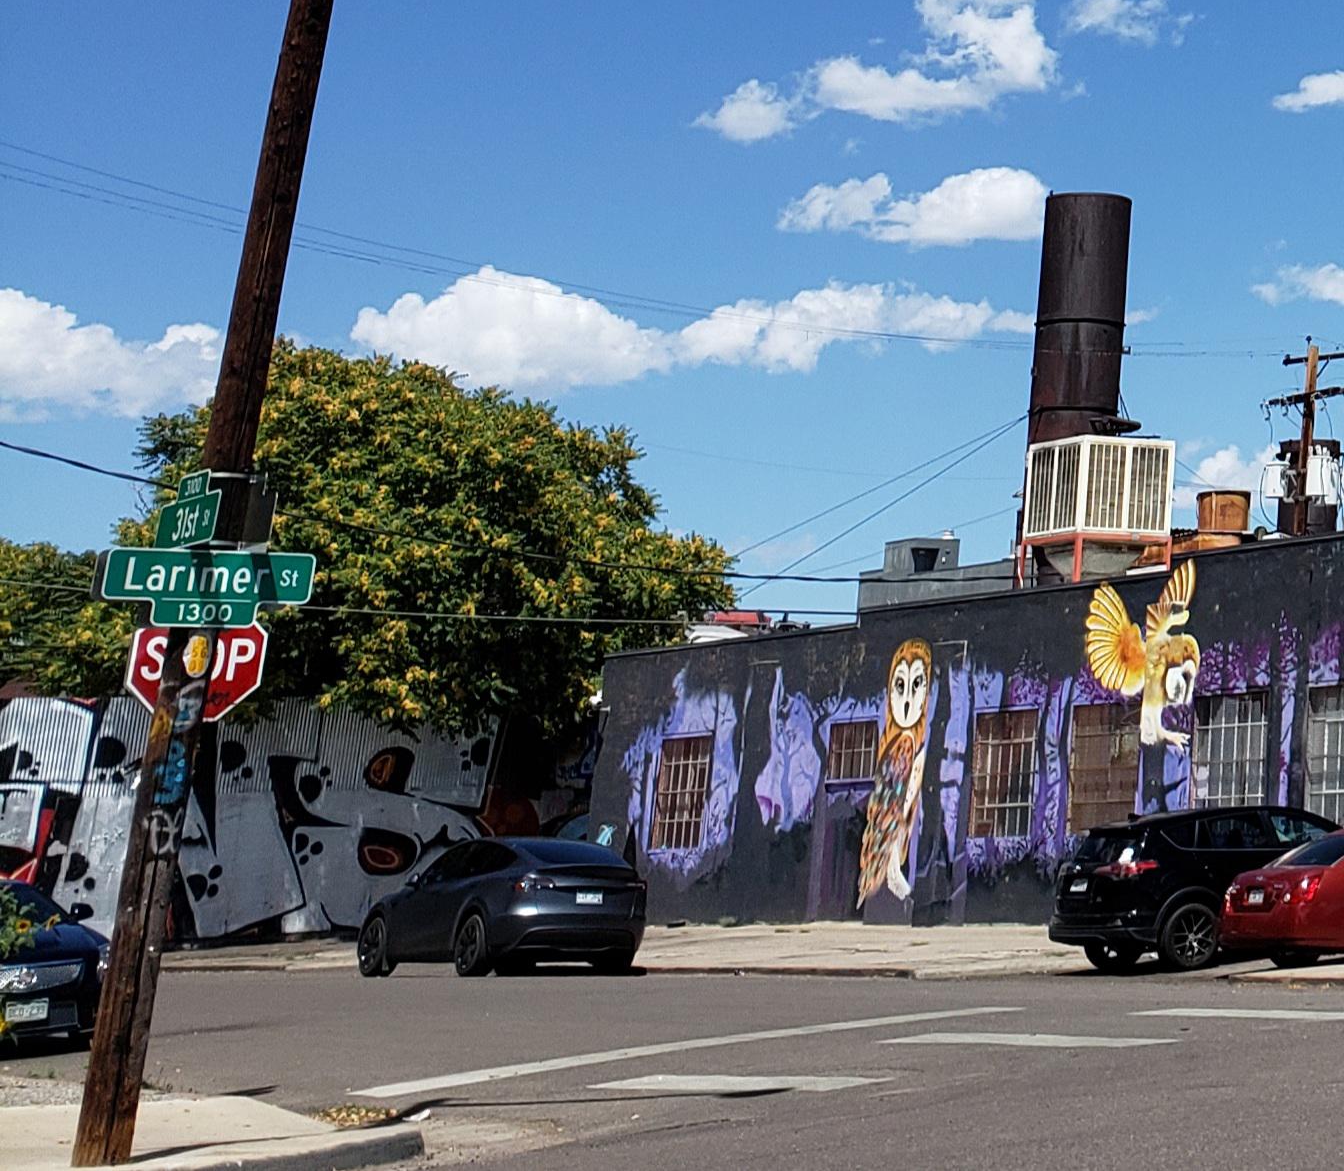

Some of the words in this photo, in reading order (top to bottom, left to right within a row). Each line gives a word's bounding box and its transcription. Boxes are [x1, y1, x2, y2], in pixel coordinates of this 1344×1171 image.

[171, 503, 200, 542] 31st
[202, 508, 211, 527] St
[124, 556, 270, 594] Larimer
[279, 569, 299, 587] St
[178, 603, 232, 622] 1300
[140, 636, 256, 681] SP
